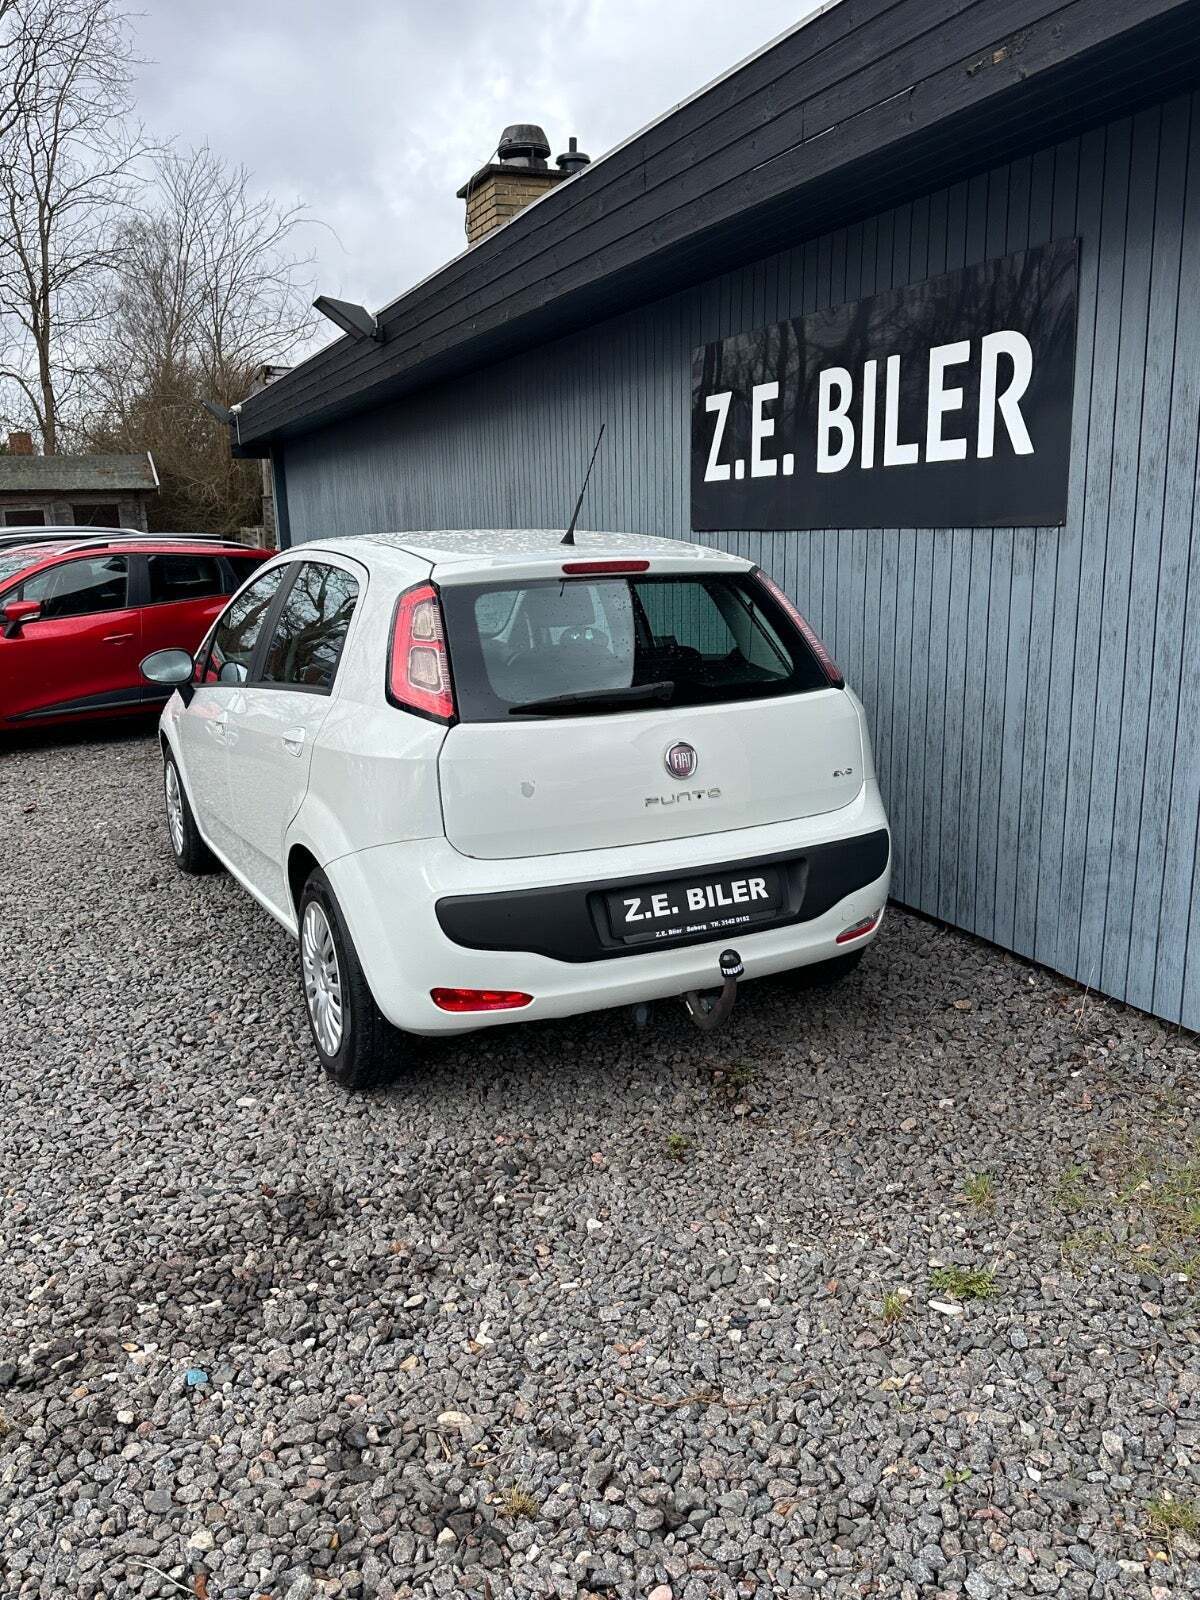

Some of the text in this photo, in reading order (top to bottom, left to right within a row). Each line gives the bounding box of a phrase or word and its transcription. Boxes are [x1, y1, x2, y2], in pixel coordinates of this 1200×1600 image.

[704, 330, 1035, 482] Z.E. BILER
[673, 752, 691, 769] FIAT
[644, 788, 721, 807] PUNTO
[623, 877, 769, 922] Z.E. BILER
